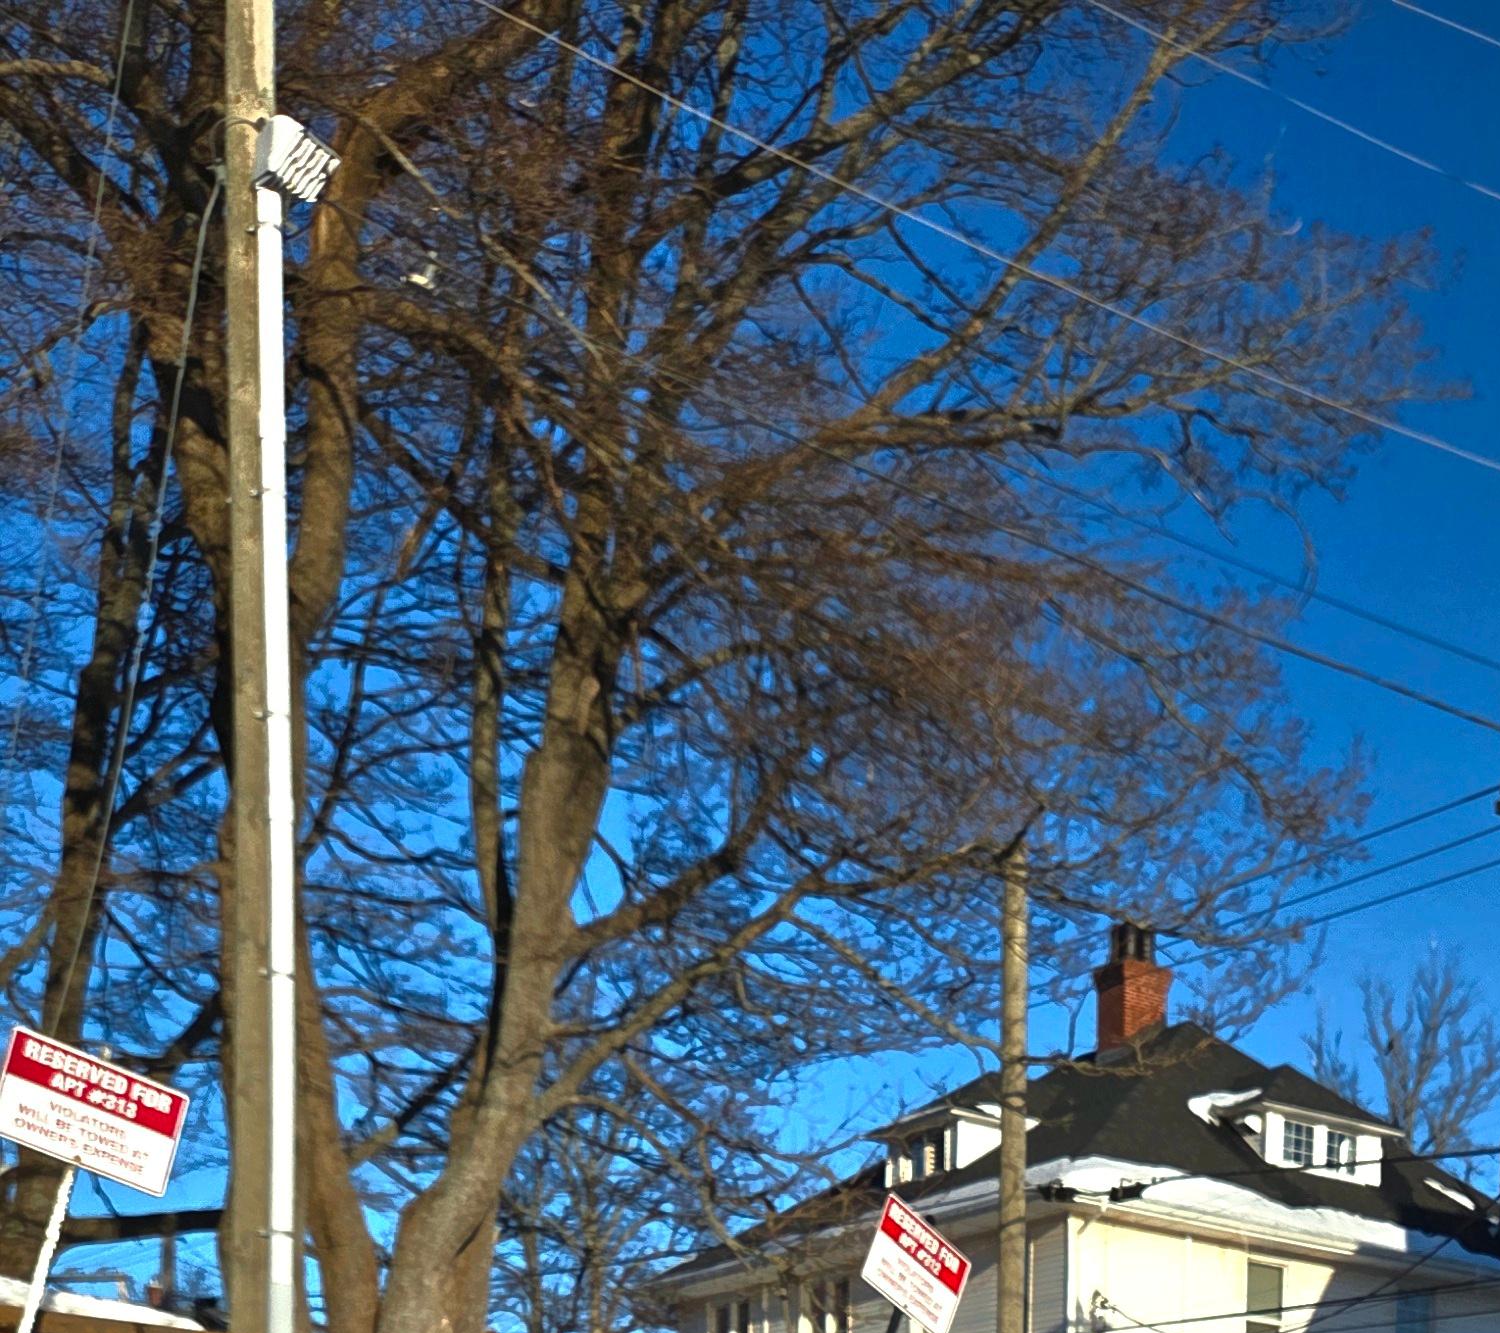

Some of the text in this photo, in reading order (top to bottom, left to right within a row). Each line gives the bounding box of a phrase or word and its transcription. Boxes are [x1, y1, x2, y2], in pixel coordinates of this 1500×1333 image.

[23, 1039, 173, 1114] RESERVED FOR
[51, 1074, 138, 1118] APT #313
[18, 1103, 49, 1123] WILL
[80, 1128, 130, 1151] TOWED
[50, 1100, 127, 1139] VIOLATORS
[82, 1143, 144, 1174] EXPENSE
[888, 1203, 940, 1255] RESERVED
[939, 1247, 960, 1275] FOR
